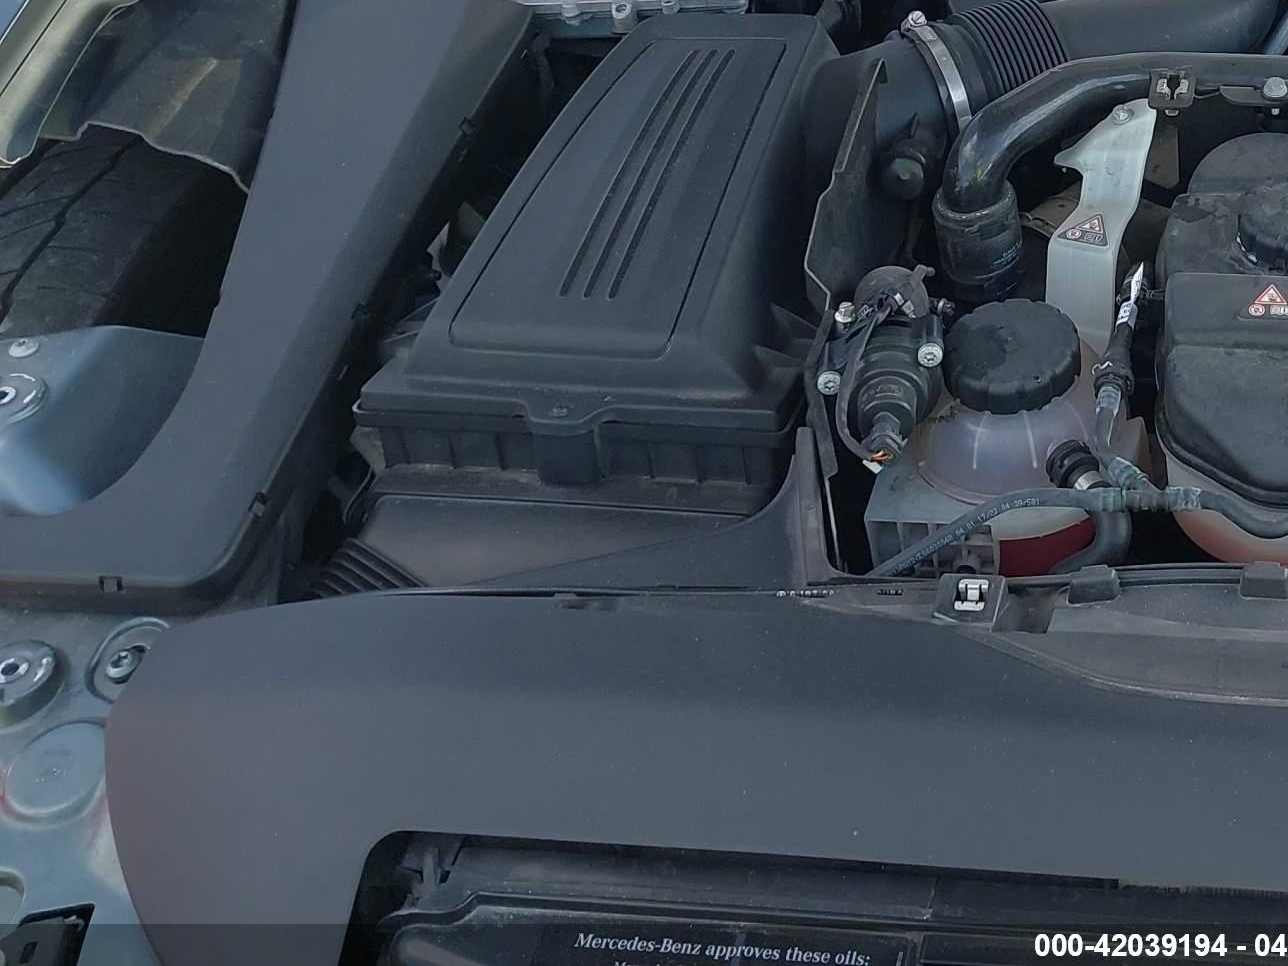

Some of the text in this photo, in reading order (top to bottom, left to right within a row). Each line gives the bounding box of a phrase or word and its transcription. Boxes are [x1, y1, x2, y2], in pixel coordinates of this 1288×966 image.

[574, 933, 871, 966] Mercedes-Benz approves these oils:
